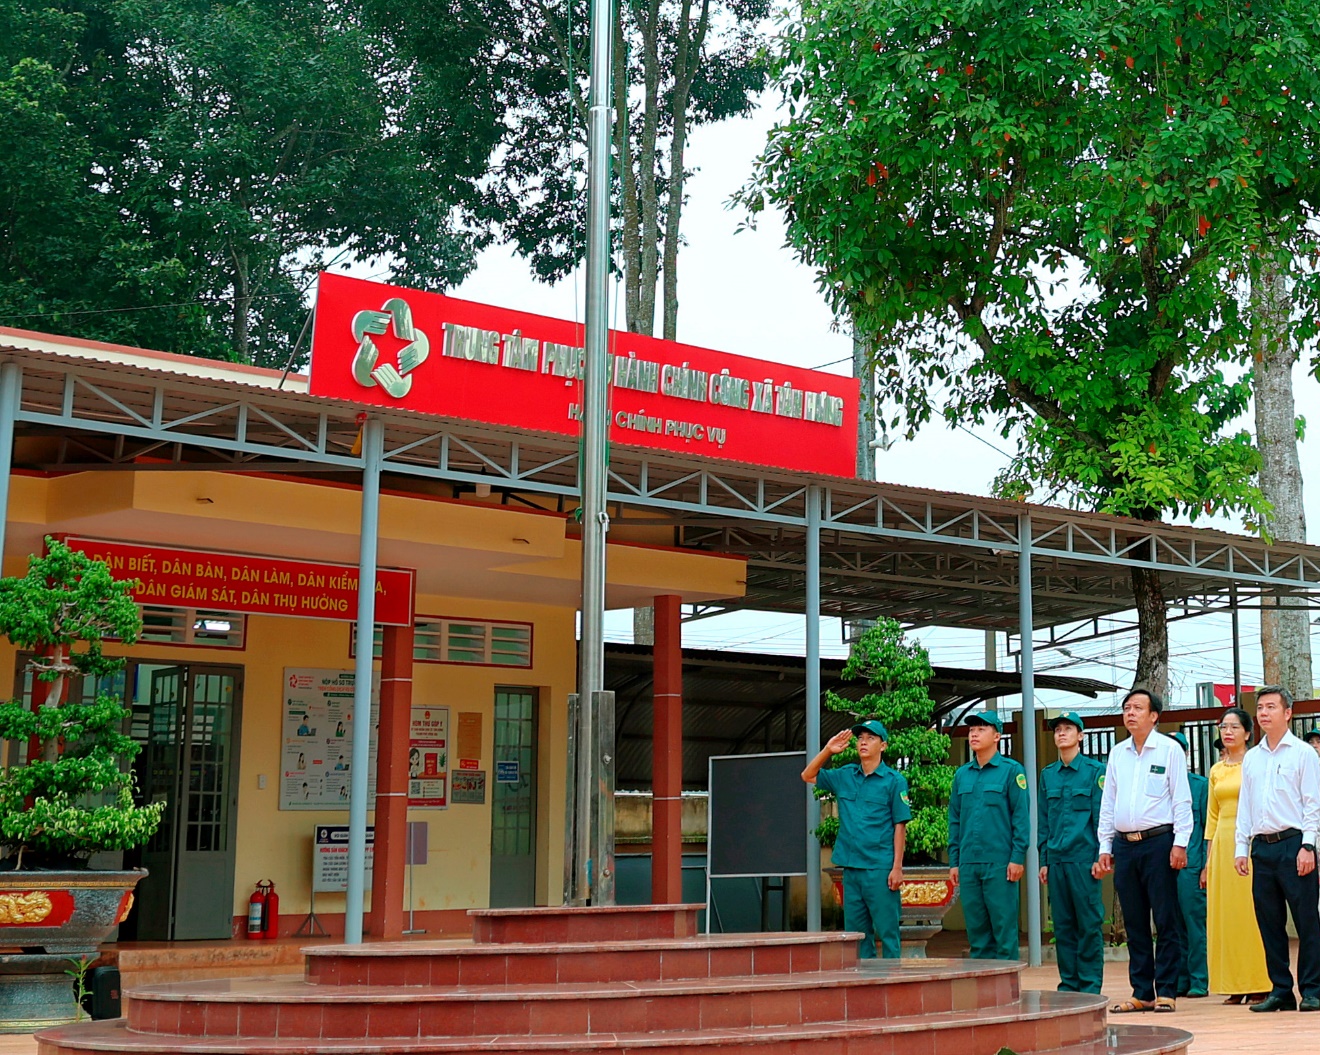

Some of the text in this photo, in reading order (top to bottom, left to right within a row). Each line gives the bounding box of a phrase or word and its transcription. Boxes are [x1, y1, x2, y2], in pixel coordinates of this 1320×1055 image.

[442, 322, 500, 365] TRUNG
[502, 329, 539, 371] TÂM
[614, 351, 660, 394] HÀNH
[661, 362, 708, 402] CHÍNH
[709, 368, 749, 410] CÔNG
[751, 378, 773, 414] XÃ
[774, 381, 804, 419] TÂN
[615, 408, 662, 435] CHÍNH
[665, 419, 704, 443] PHỤC
[706, 426, 727, 449] VỤ
[128, 553, 157, 575] BIẾT,
[162, 558, 192, 575] DÂN
[196, 561, 227, 581] BÀN,
[231, 566, 259, 582] DÂN
[263, 567, 294, 587] LÀM,
[298, 571, 325, 588] DÂN
[329, 571, 358, 591] KIỂM
[136, 579, 166, 597] DÂN
[170, 583, 208, 601] GIÁM
[211, 586, 237, 605] SÁT,
[241, 588, 270, 606] DÂN
[273, 594, 298, 611] THỤ
[301, 592, 349, 612] HƯỞNG
